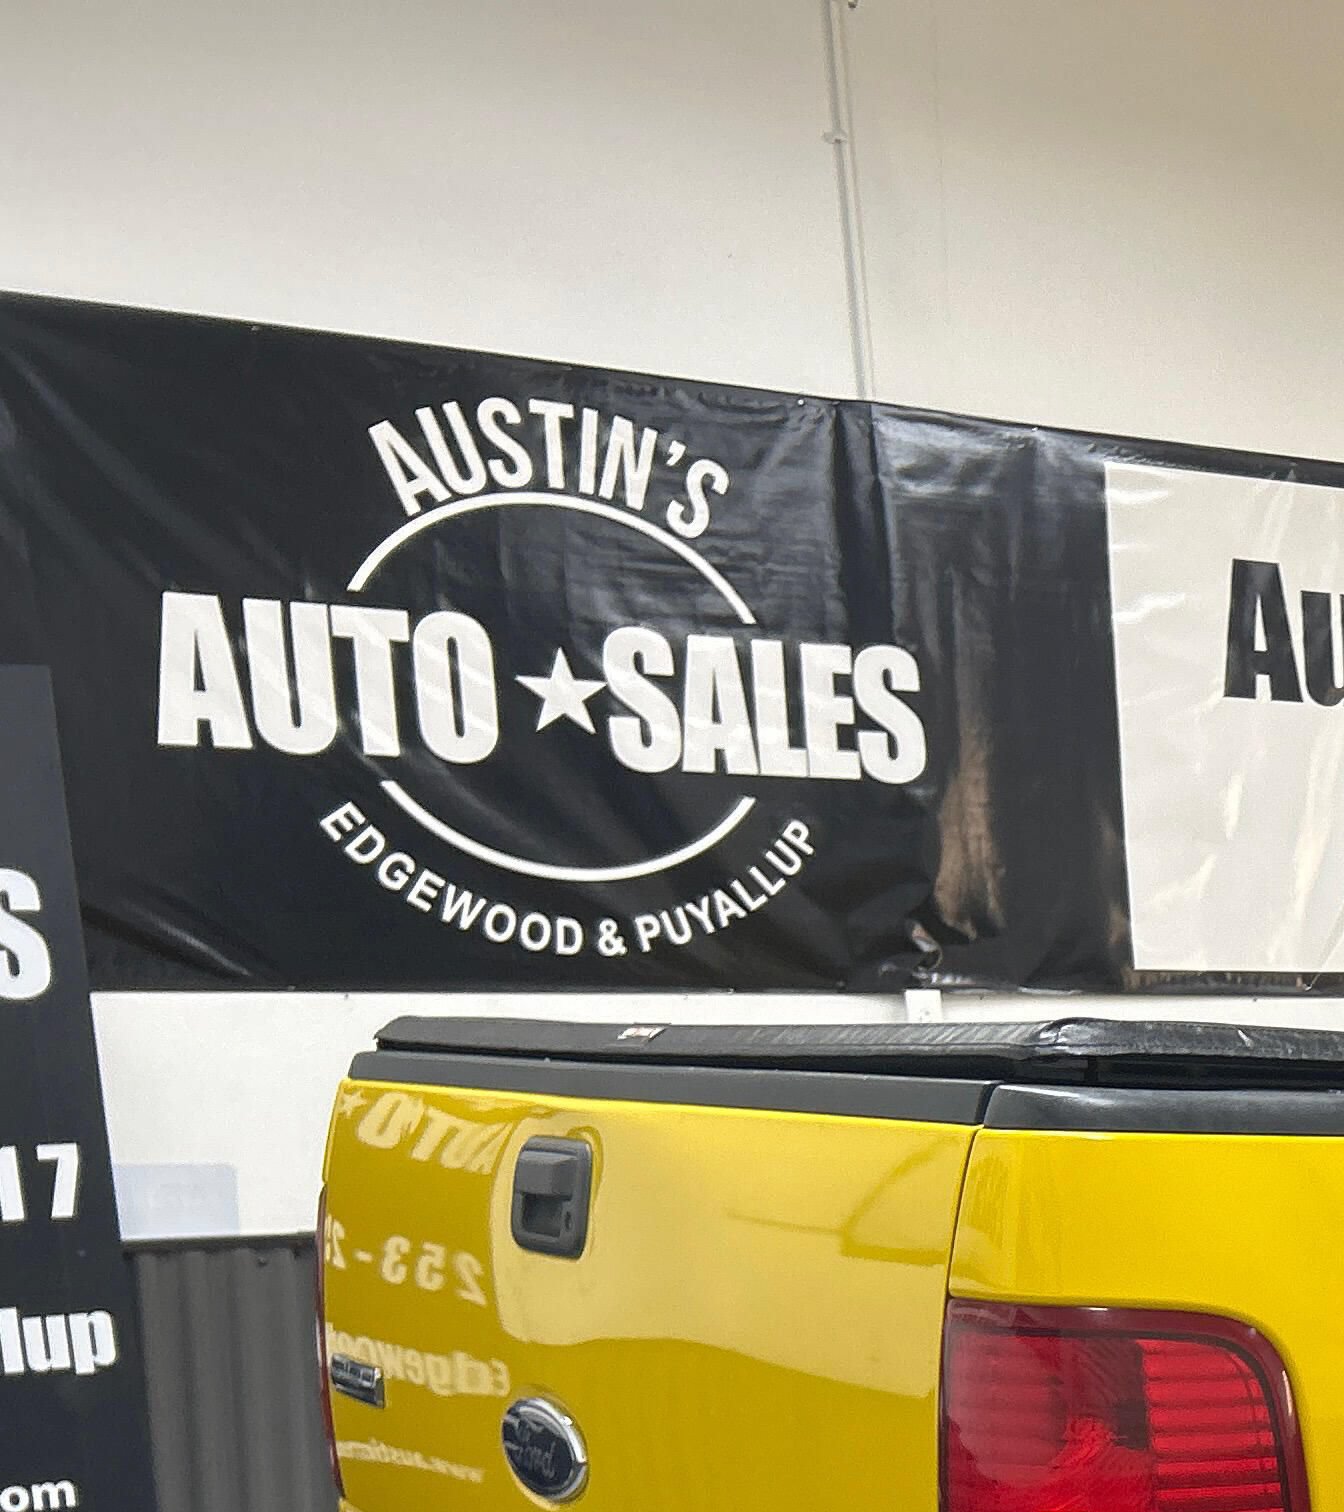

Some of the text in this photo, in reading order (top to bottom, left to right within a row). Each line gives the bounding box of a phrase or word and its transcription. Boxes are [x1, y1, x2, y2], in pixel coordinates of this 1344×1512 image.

[368, 397, 729, 539] AUSTIN'S
[158, 591, 928, 784] AUTO SALES
[320, 802, 817, 957] EDGEWOOD & PUYALLUP
